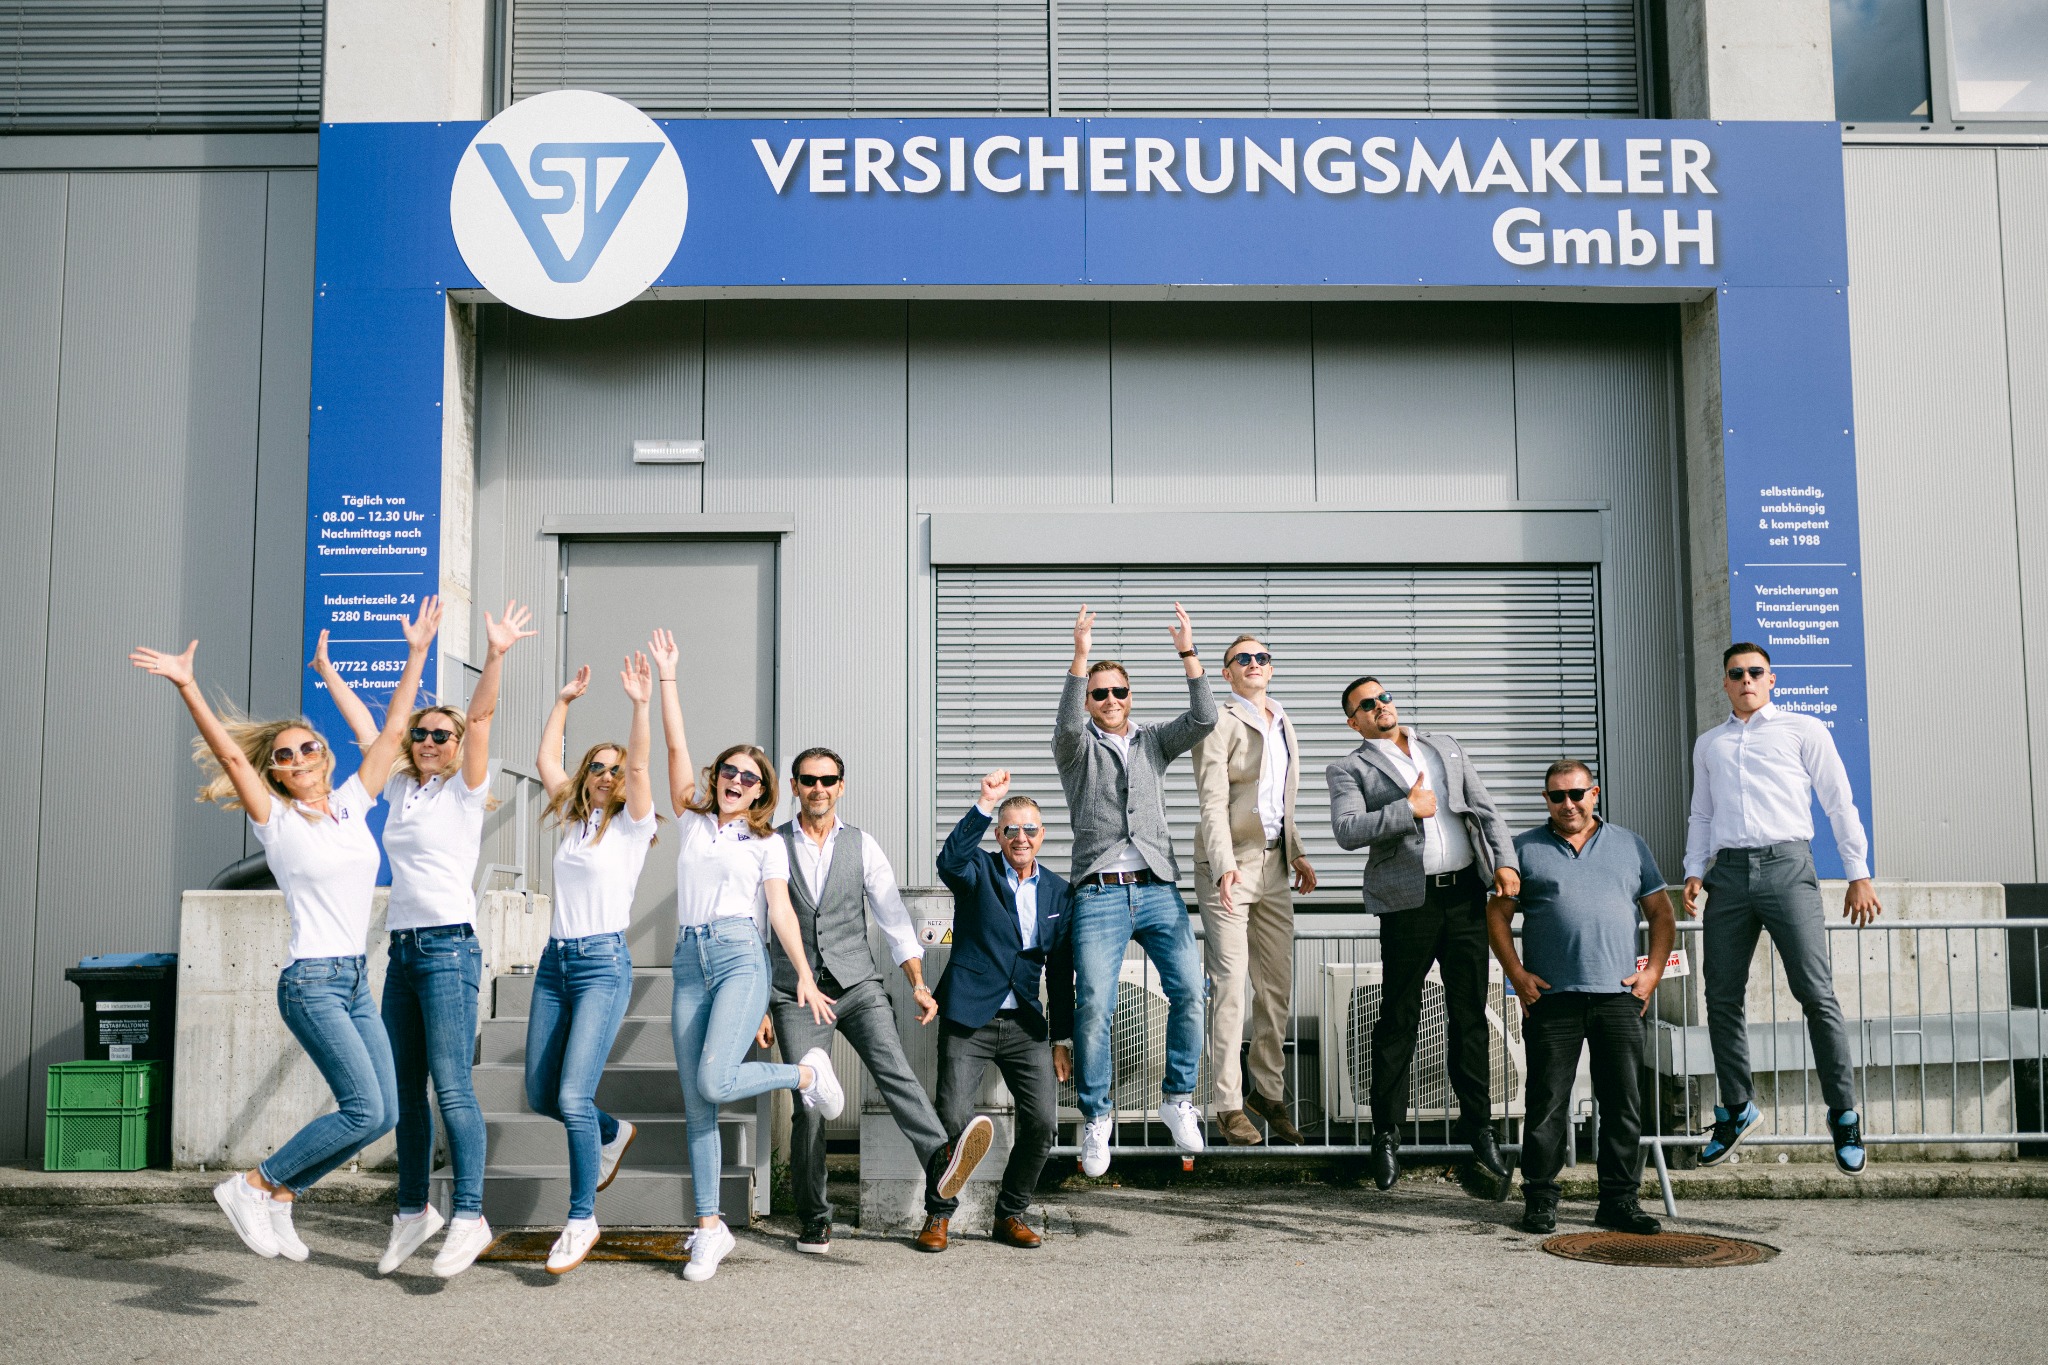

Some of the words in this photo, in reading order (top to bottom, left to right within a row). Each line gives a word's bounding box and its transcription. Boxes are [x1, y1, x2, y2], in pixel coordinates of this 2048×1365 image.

[752, 135, 1718, 195] VERSICHERUNGSMAKLER
[1492, 207, 1715, 266] GmbH
[1760, 485, 1825, 499] selbständig,
[341, 494, 383, 508] Täglich
[386, 497, 406, 505] von
[1761, 502, 1826, 515] unabhängig
[322, 511, 355, 522] 08.00
[368, 510, 400, 522] 12.30
[403, 510, 425, 522] Uhr
[1759, 518, 1769, 530] &
[1771, 518, 1830, 532] kompetent
[321, 528, 392, 541] Nachmittags
[394, 527, 422, 538] nach
[1769, 535, 1789, 546] seit
[1792, 535, 1821, 546] 1988
[317, 544, 428, 557] Terminvereinbarung
[1754, 584, 1839, 598] Versicherungen
[324, 594, 398, 606] Industriezeile
[400, 593, 416, 605] 24
[1755, 601, 1840, 614] Finanzierungen
[331, 610, 361, 622] 5280
[363, 610, 410, 622] Braunau
[1757, 618, 1839, 631] Veranlagungen
[1768, 634, 1830, 645] Immobilien
[332, 661, 368, 672] 07722
[370, 660, 407, 672] 68537
[1773, 685, 1829, 697] garantiert
[1774, 701, 1838, 714] nabhängige
